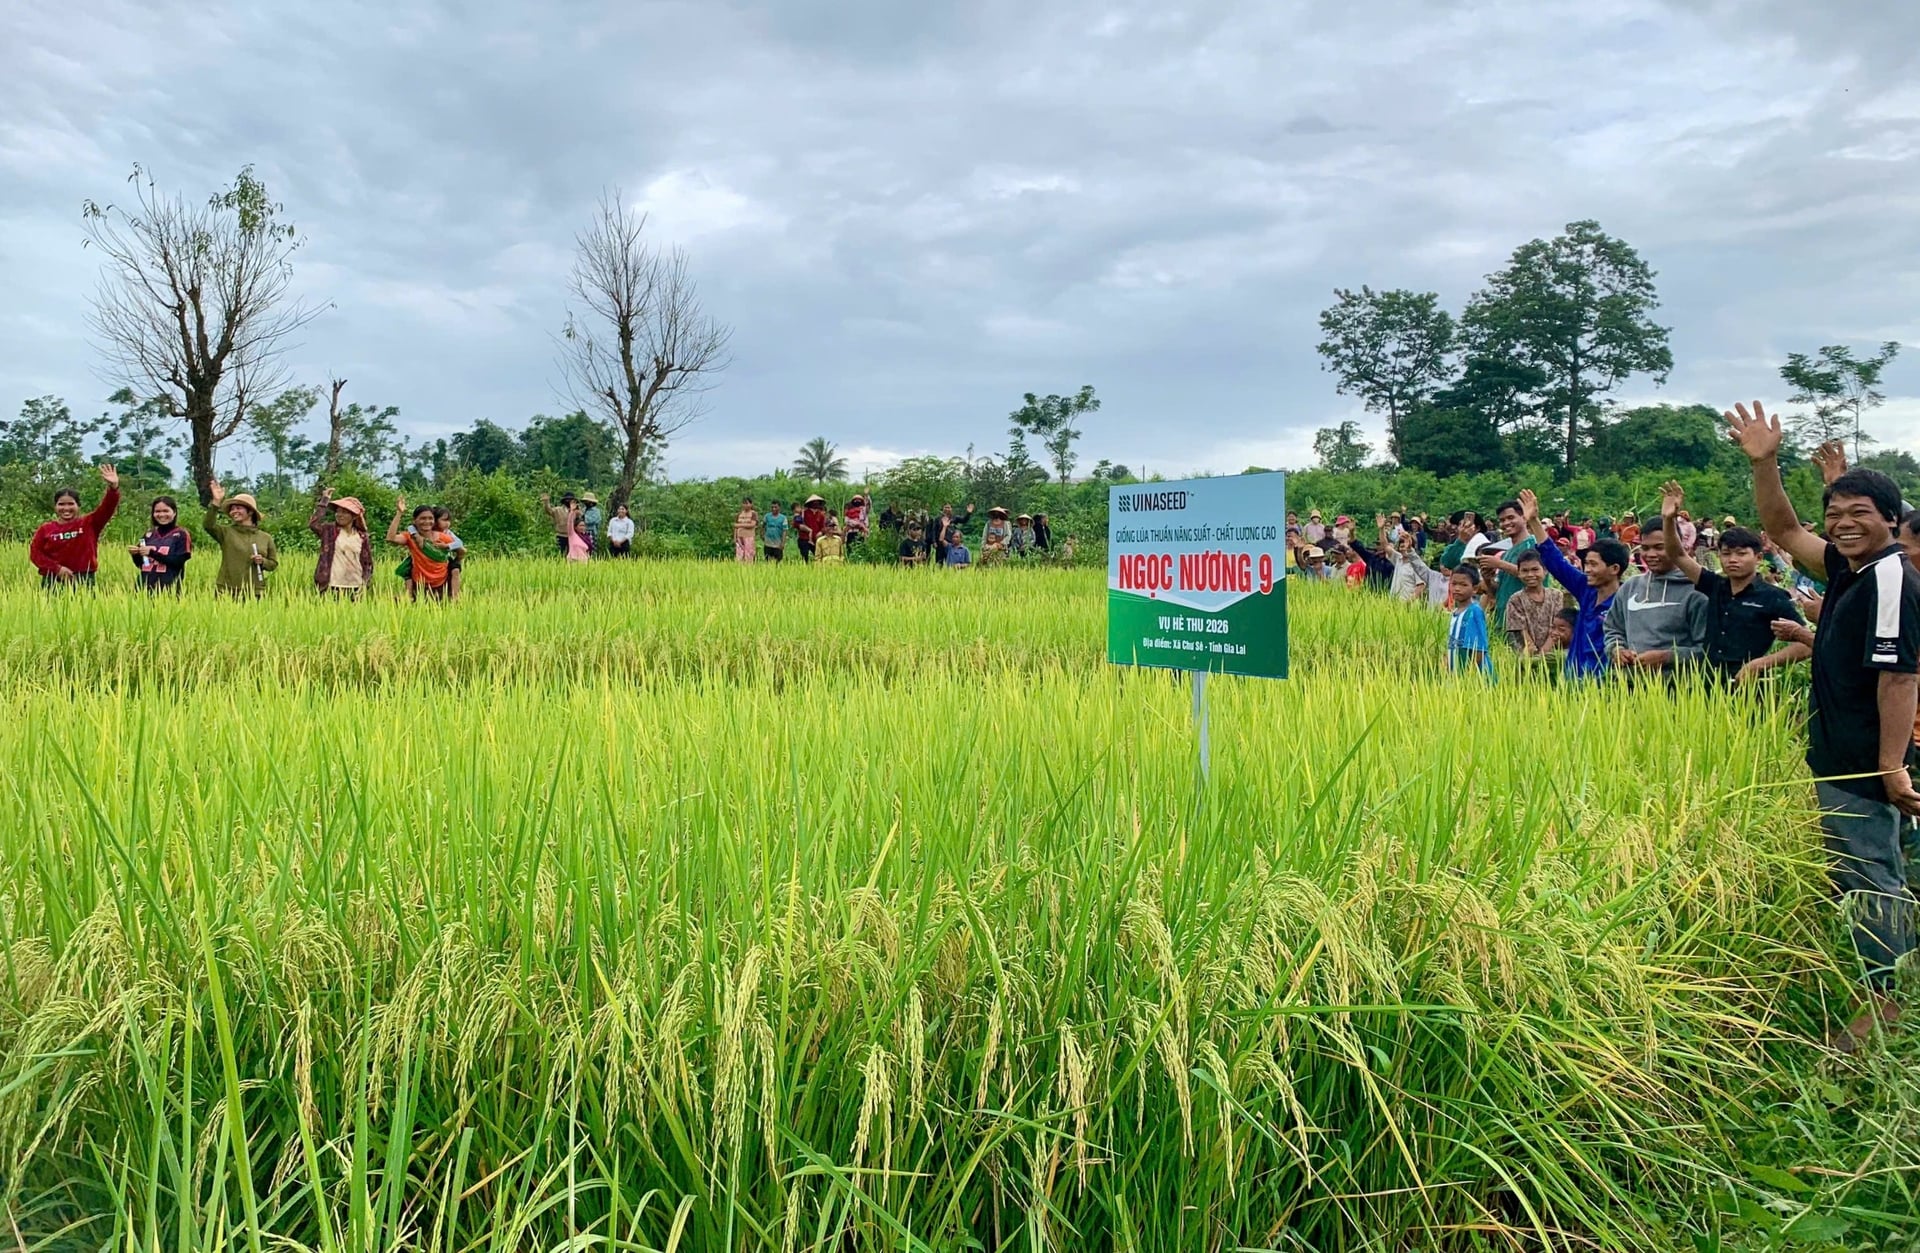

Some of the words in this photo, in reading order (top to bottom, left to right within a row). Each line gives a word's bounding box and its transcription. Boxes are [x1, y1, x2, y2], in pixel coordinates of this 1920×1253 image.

[1132, 491, 1186, 512] VINASEED
[1261, 526, 1277, 540] CAO
[1119, 553, 1173, 598] NGỌC
[1179, 550, 1252, 593] NƯƠNG
[1259, 554, 1273, 593] 9
[1158, 616, 1170, 633] VỤ
[1186, 617, 1204, 632] THU
[1206, 619, 1229, 634] 2026
